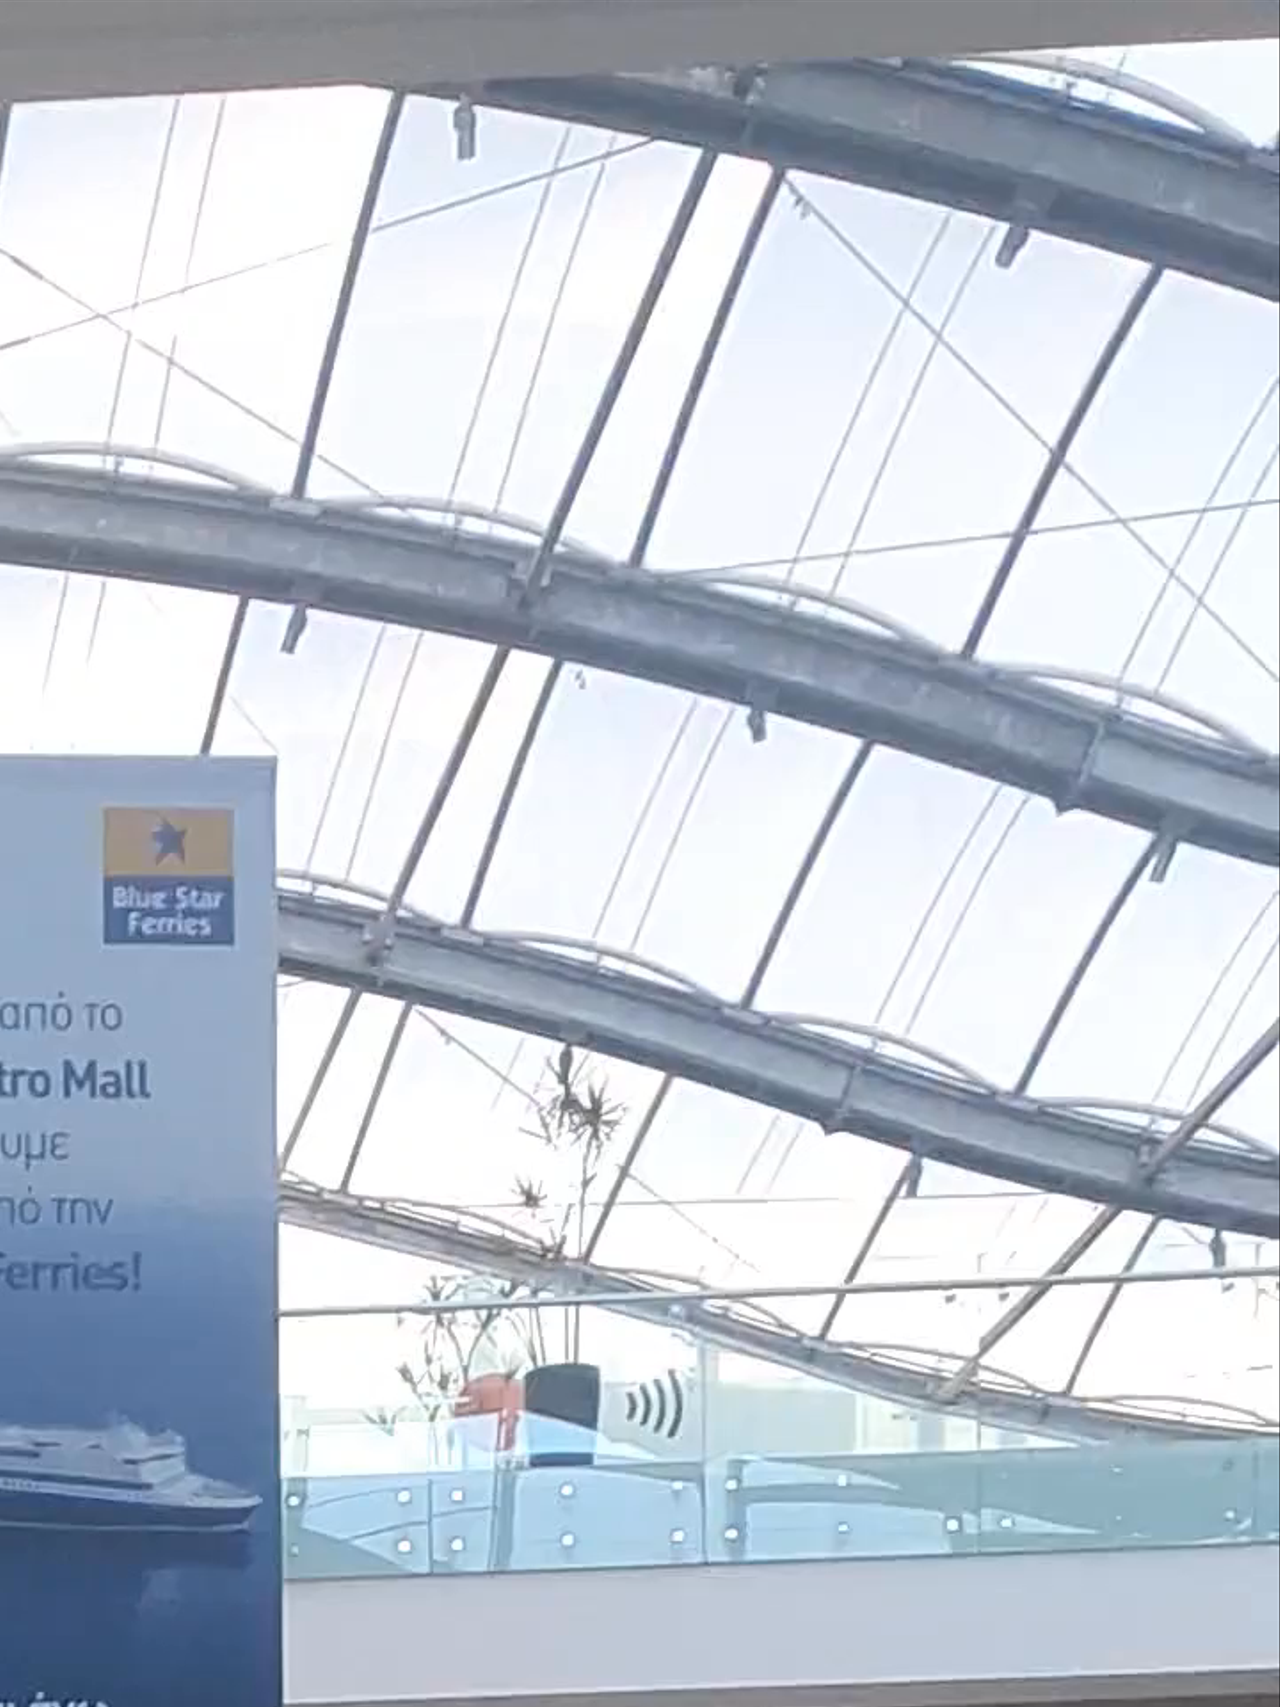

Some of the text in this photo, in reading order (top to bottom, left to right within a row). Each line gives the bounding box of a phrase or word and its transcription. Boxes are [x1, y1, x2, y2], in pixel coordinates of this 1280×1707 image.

[112, 884, 225, 910] Blue Star
[126, 914, 212, 938] Ferries
[84, 1001, 123, 1032] το
[63, 1059, 151, 1100] Mall
[50, 1196, 113, 1225] την
